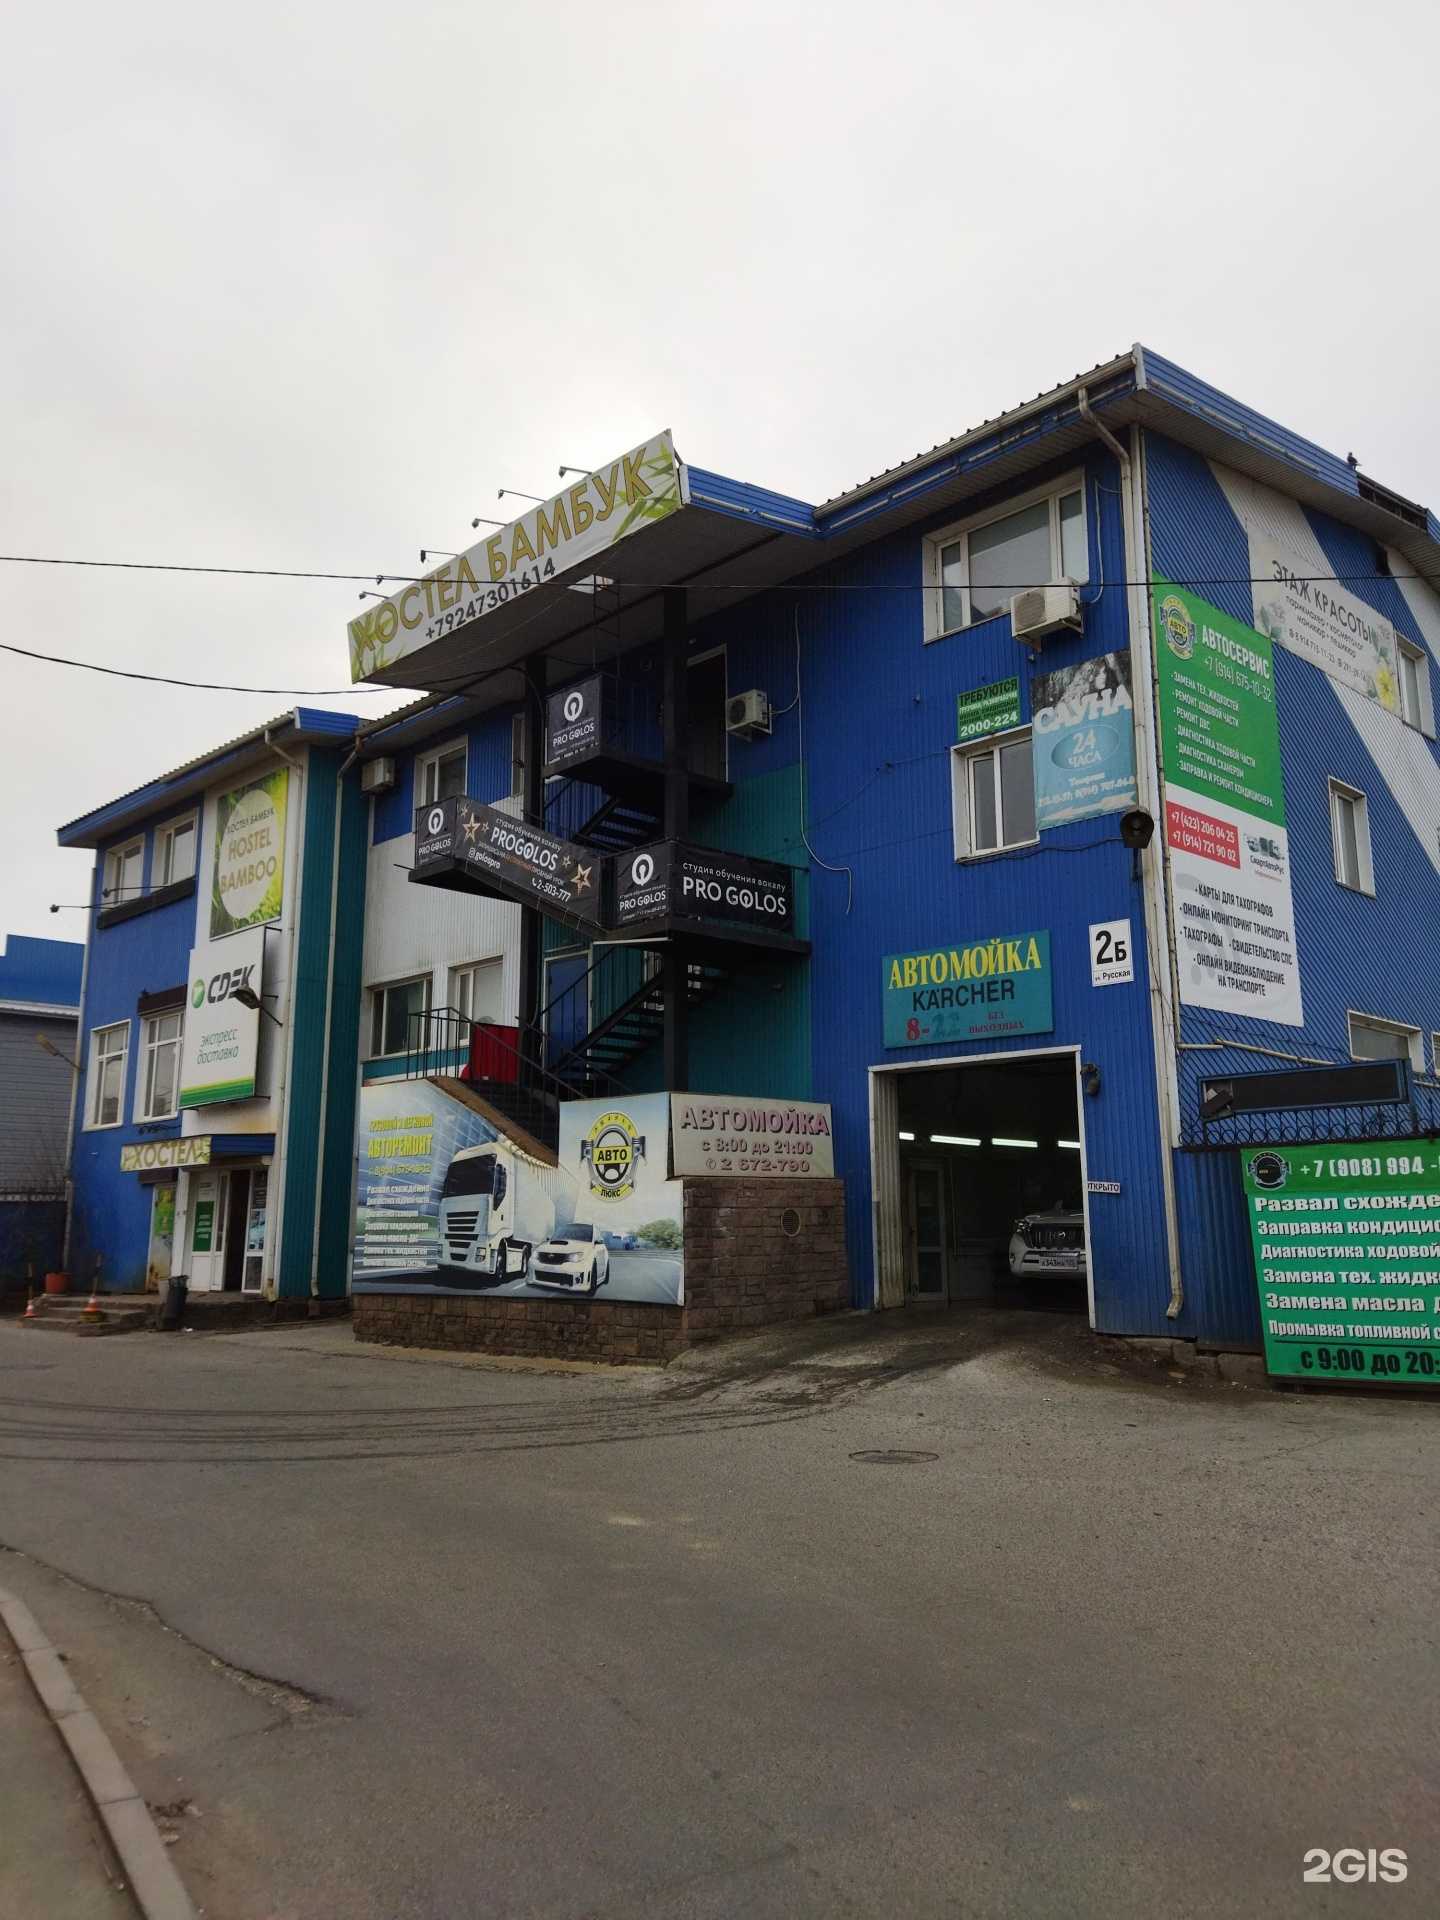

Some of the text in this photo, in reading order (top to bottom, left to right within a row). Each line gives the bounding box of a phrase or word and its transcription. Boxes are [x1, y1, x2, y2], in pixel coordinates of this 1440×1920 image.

[351, 447, 653, 653] ХОСТЕЛ БАМБУК
[1272, 560, 1372, 645] ЭТАЖ КРАСОТЫ
[1202, 624, 1269, 679] АВТОСЕРВИС
[960, 679, 1018, 707] ТРЕБУЮТСЯ
[1033, 684, 1132, 735] САУНА
[1177, 706, 1198, 726] РЕМОНТ
[961, 710, 1018, 737] 2000-224
[553, 734, 568, 748] PRO
[1072, 728, 1096, 754] 24
[1068, 751, 1102, 769] ЧАСА
[1201, 821, 1215, 836] 206
[228, 827, 272, 862] HOSTEL
[418, 844, 430, 856] PRO
[490, 826, 559, 871] PROGOLOS
[221, 856, 277, 894] BAMBOO
[682, 862, 786, 894] студия обучения вокалу
[537, 879, 571, 902] 2-503-777
[620, 898, 636, 911] PRO
[637, 890, 666, 906] GOLOS
[683, 876, 722, 901] PRO
[726, 886, 786, 916] GOLOS
[1198, 883, 1273, 917] КАРТЫ ДЛЯ ТАХОГРАФОВ
[1183, 902, 1289, 943] ОНЛАЙН МОНИТОРИНГ ТРАНСПОРТА
[1096, 930, 1127, 964] 2Б
[1183, 926, 1223, 947] ТАХОГРАФЫ
[1232, 938, 1280, 962] СВИДЕТЕЛЬСТВО
[888, 937, 1042, 990] АВТОМОЙКА
[1103, 970, 1130, 981] Русская
[1197, 953, 1285, 985] ОНЛАЙН ВИДЕОНАБЛЮДЕНИЕ
[913, 979, 1015, 1011] KÄRCHER
[1218, 974, 1265, 996] НА ТРАНСПОРТЕ
[681, 1106, 830, 1136] АВТОМОЙКА
[132, 1140, 197, 1169] ХОСТЕЛ
[597, 1149, 628, 1162] АВТО
[774, 1140, 814, 1155] 21:00
[720, 1158, 733, 1171] 2
[1386, 1155, 1424, 1176] 994
[601, 1189, 621, 1198] ЛЮКС
[1088, 1182, 1119, 1192] ТКРЫТО
[1254, 1197, 1339, 1212] Развал
[1257, 1220, 1344, 1236] Заправка
[1260, 1241, 1440, 1260] Диагностика ходовой
[1263, 1268, 1335, 1284] Замена
[1339, 1270, 1376, 1284] тех.
[1266, 1293, 1347, 1310] Замена
[1352, 1295, 1425, 1312] масла
[1268, 1320, 1345, 1337] Промывка
[1347, 1323, 1430, 1340] топливной
[1301, 1351, 1313, 1369] с
[1318, 1349, 1364, 1371] 9:00
[1371, 1353, 1400, 1376] до
